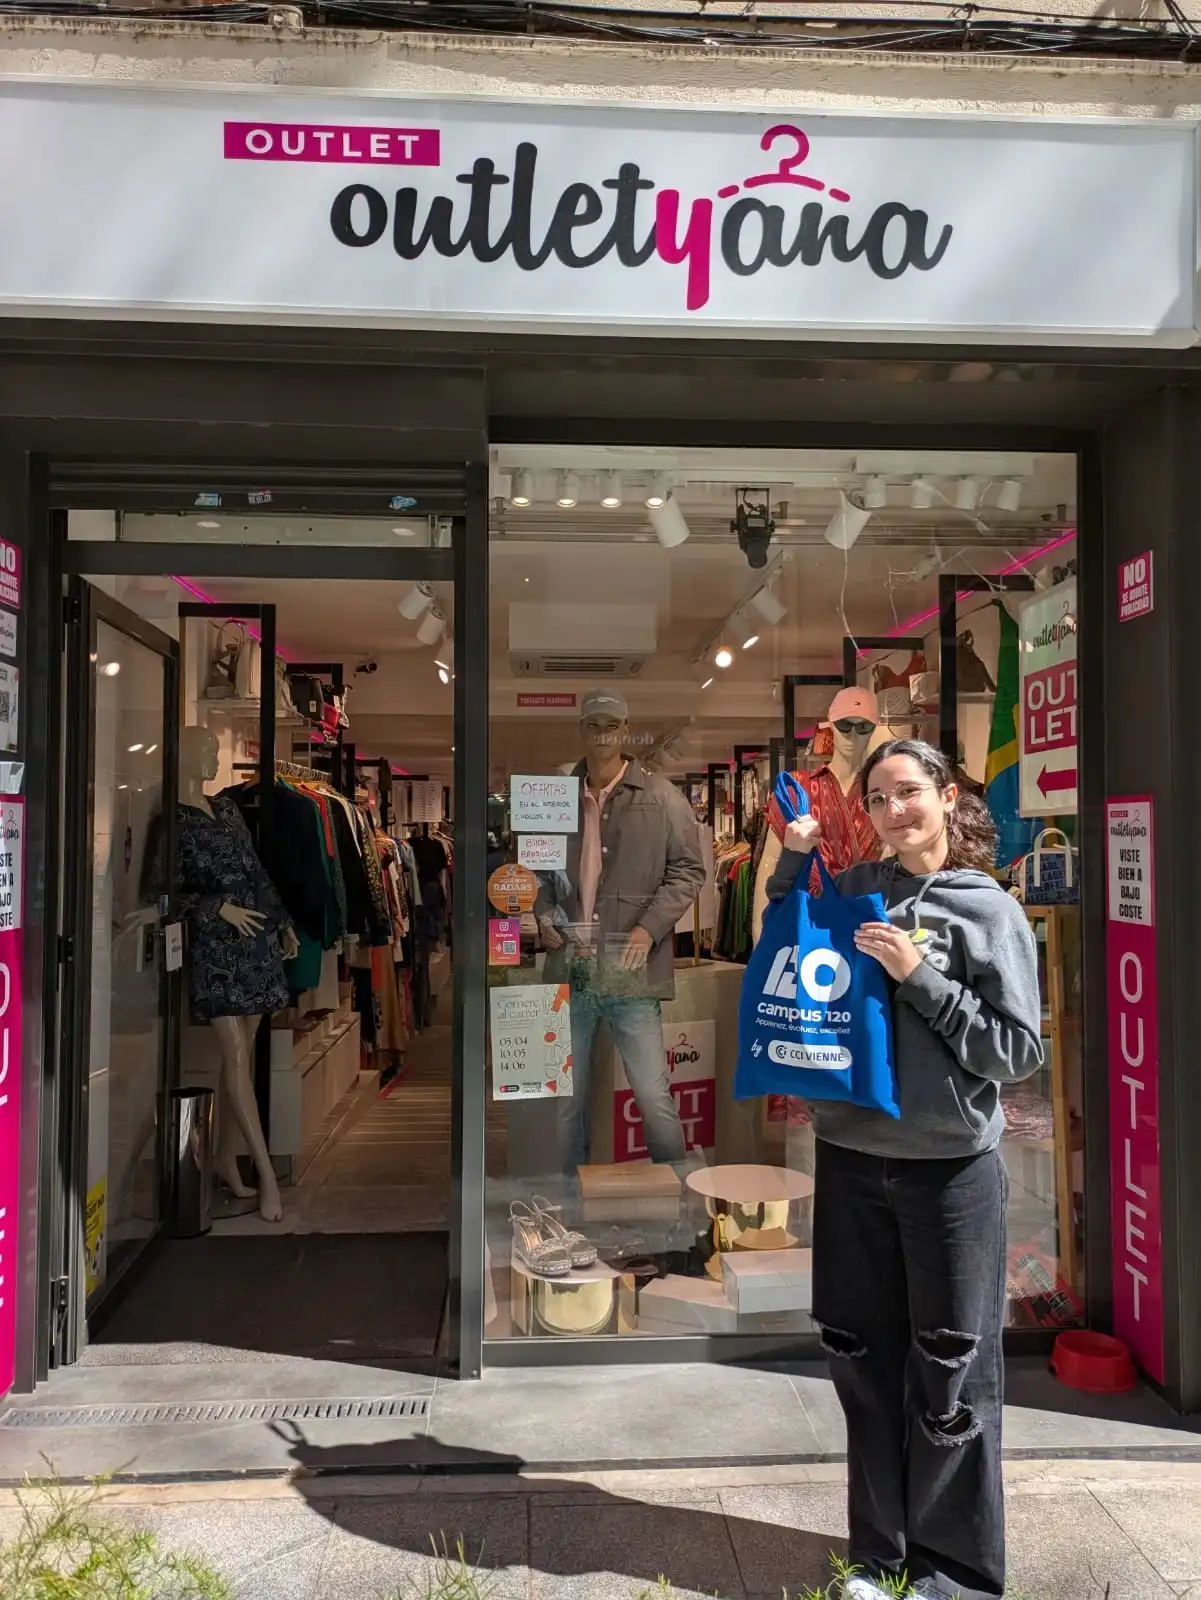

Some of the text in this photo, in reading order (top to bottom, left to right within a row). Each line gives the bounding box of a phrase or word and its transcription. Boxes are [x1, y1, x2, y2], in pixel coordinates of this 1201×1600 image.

[245, 129, 420, 160] OUTLET
[330, 142, 954, 311] outletyana
[1123, 558, 1146, 589] NO
[1120, 848, 1140, 863] VISTE
[9, 872, 14, 887] A
[1118, 866, 1142, 881] BIEN A
[494, 883, 533, 892] RADARS
[1120, 885, 1140, 900] BAJO
[1119, 903, 1143, 920] COSTE
[757, 1002, 851, 1023] campus 120
[750, 1038, 763, 1058] by
[790, 1049, 845, 1062] CCI VIENNE
[1119, 951, 1149, 1322] OUTLET
